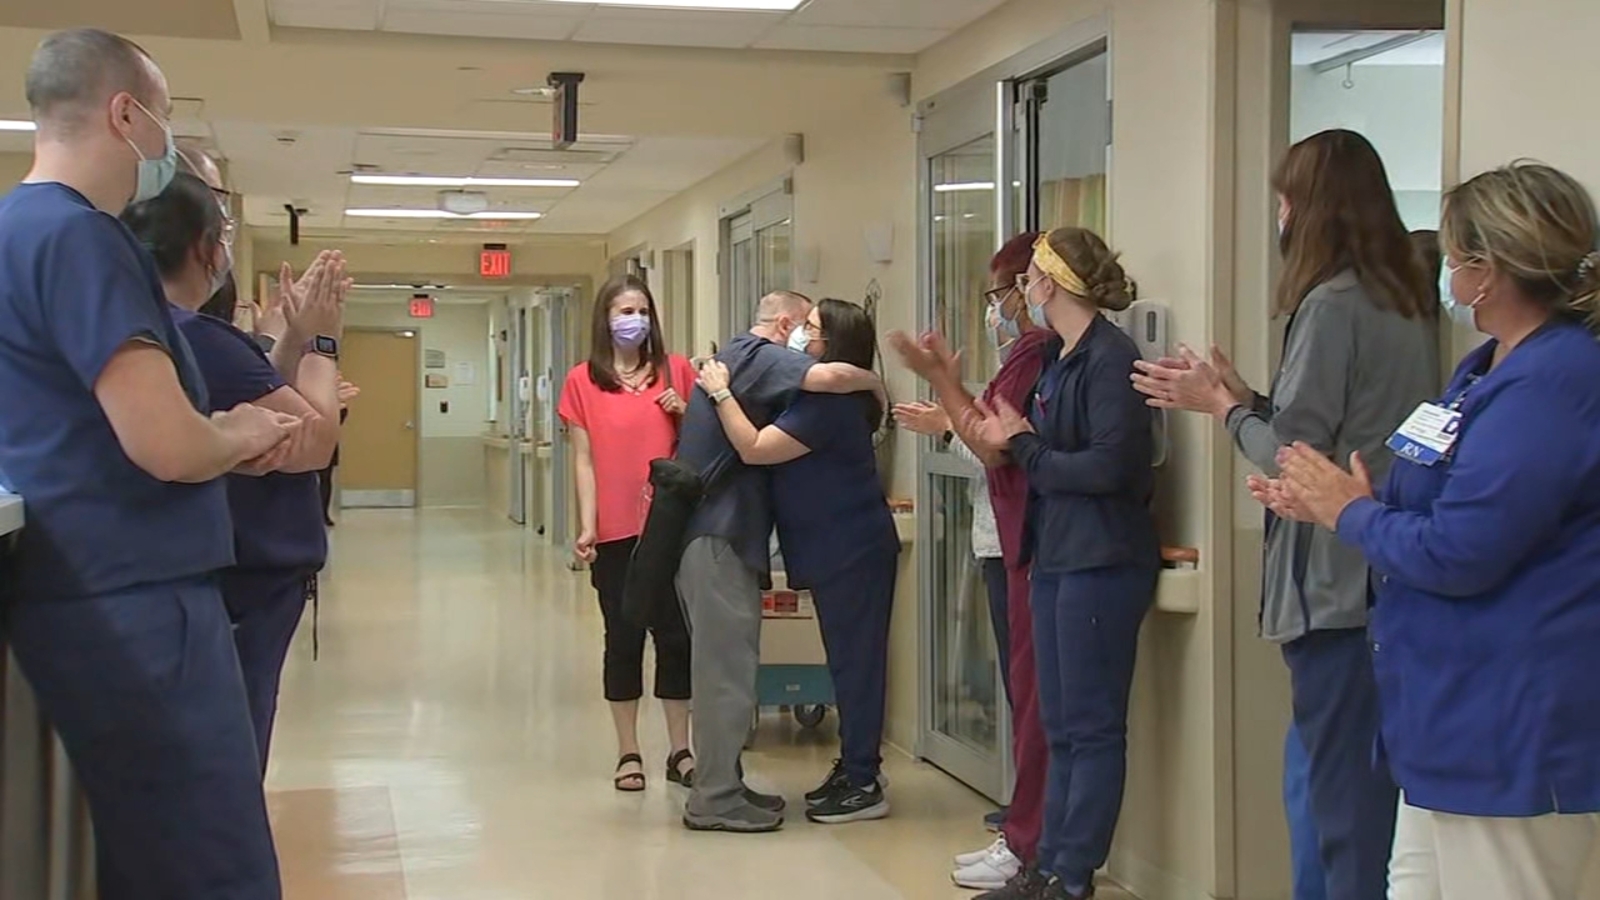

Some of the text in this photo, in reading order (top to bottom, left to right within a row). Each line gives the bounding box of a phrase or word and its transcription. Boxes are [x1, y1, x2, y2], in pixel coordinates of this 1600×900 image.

[481, 253, 510, 275] EXIT
[410, 301, 431, 316] EXIT
[1400, 442, 1423, 457] RN
